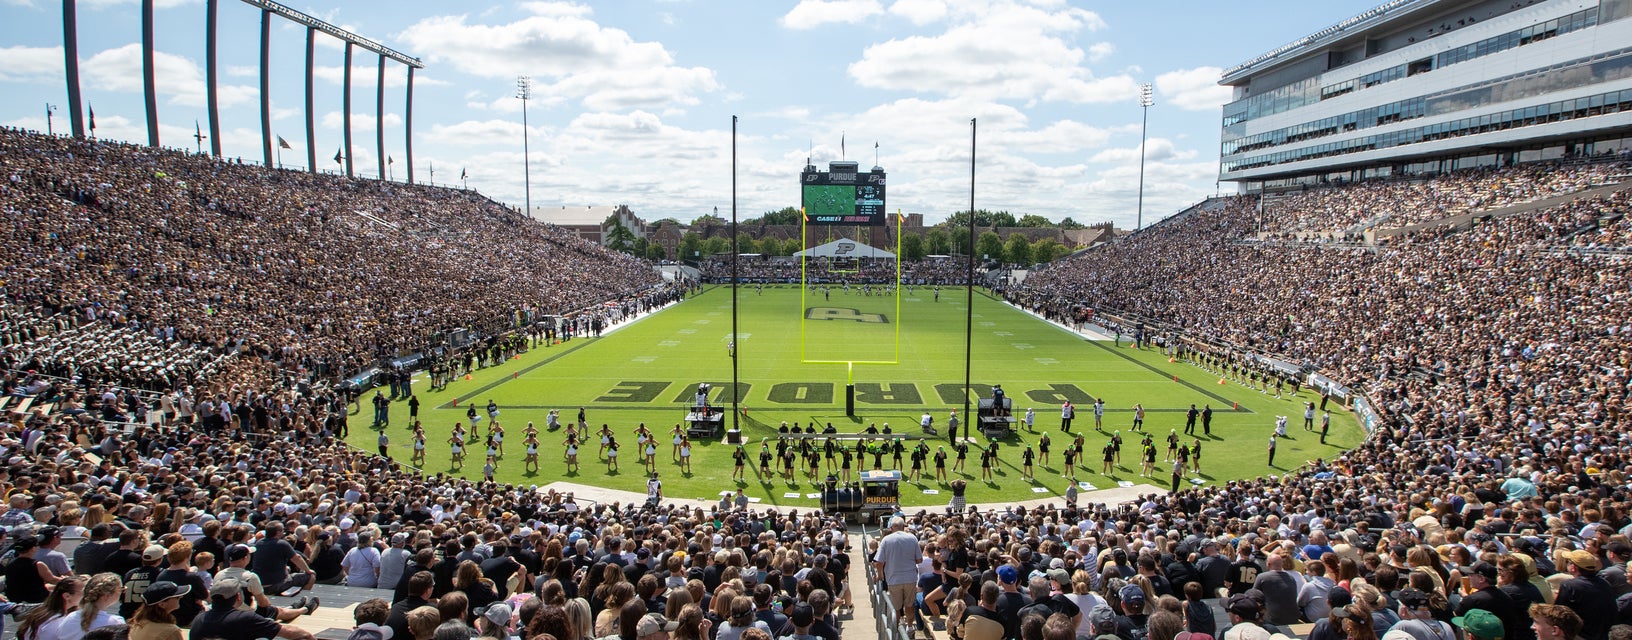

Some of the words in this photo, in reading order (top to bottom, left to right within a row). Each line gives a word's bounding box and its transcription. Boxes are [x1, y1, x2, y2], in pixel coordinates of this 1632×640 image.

[828, 172, 856, 180] PURDUE
[834, 242, 856, 254] P
[593, 381, 1098, 404] PURDUE
[1240, 566, 1257, 584] 16
[124, 580, 150, 602] 15
